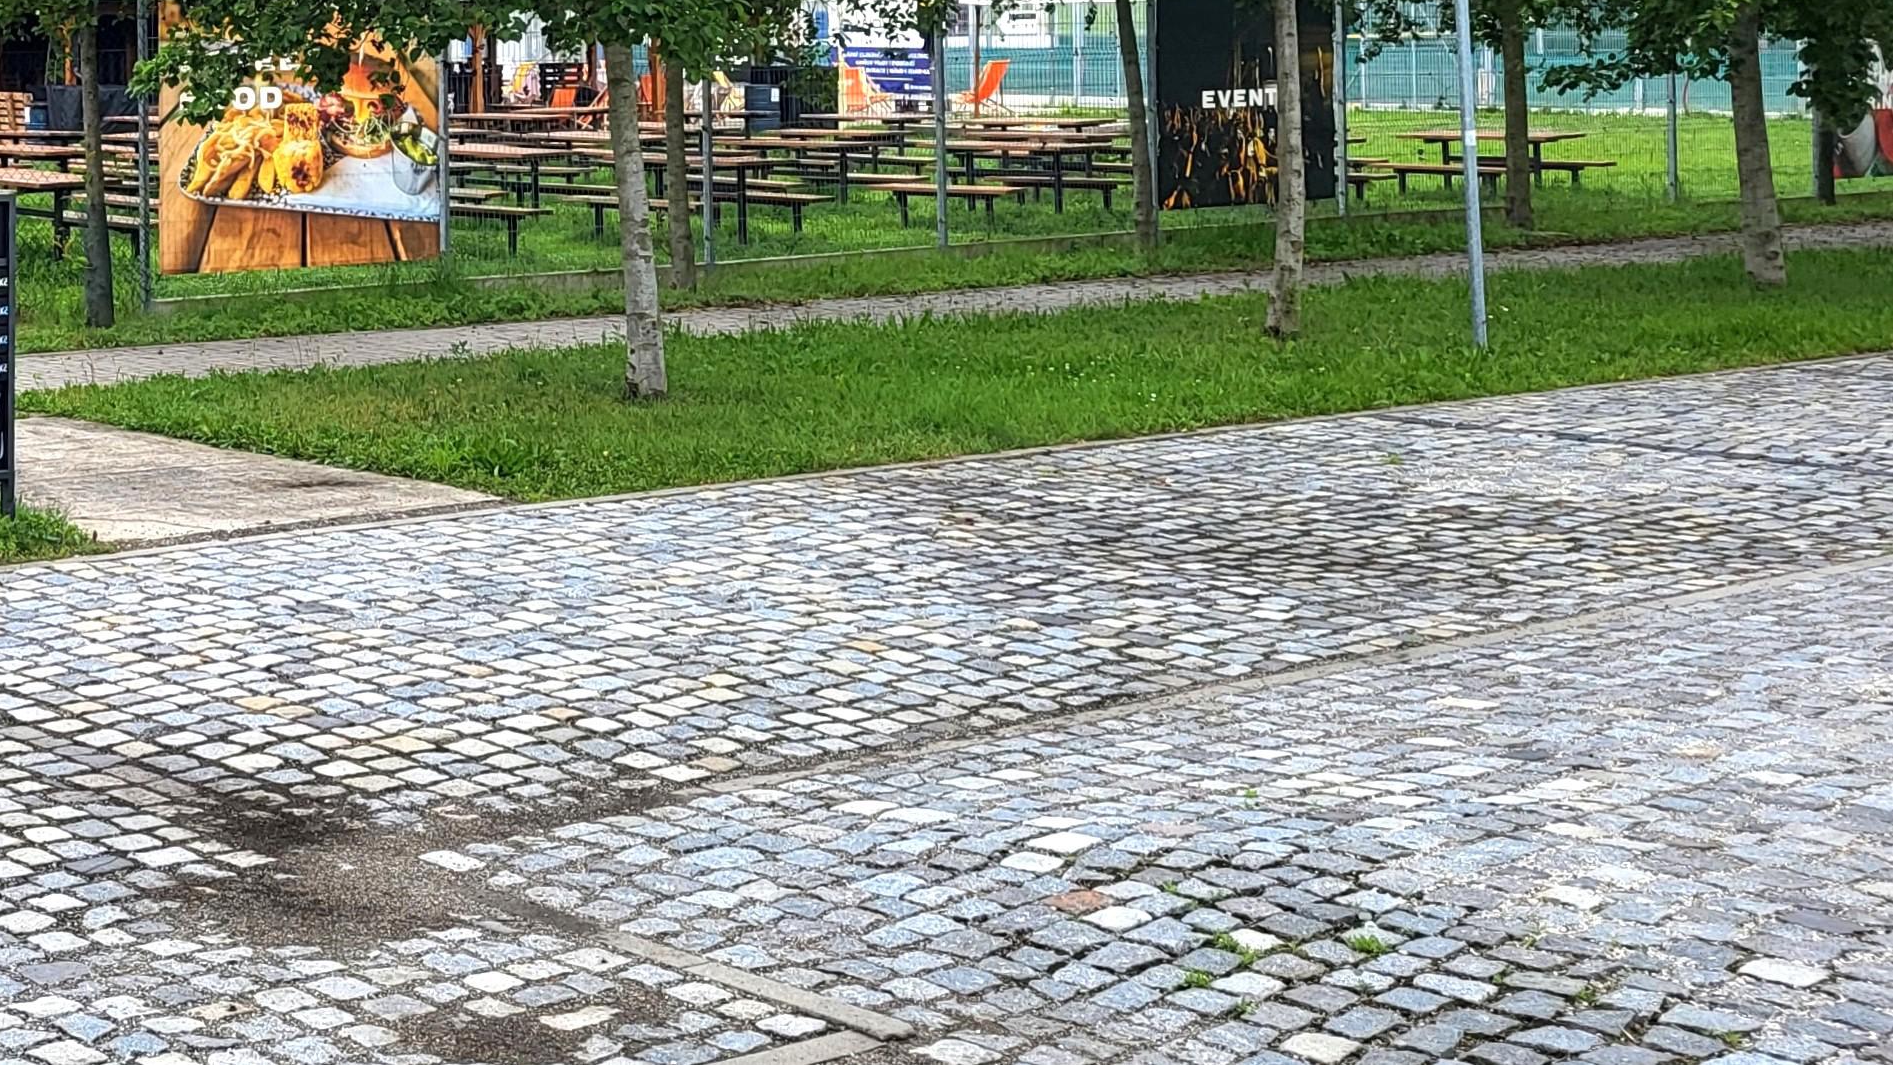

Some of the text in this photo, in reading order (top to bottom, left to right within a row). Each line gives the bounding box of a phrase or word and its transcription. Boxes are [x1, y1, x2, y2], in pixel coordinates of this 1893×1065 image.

[0, 277, 8, 287] Kč
[0, 306, 9, 316] Kč
[0, 335, 8, 345] Kč
